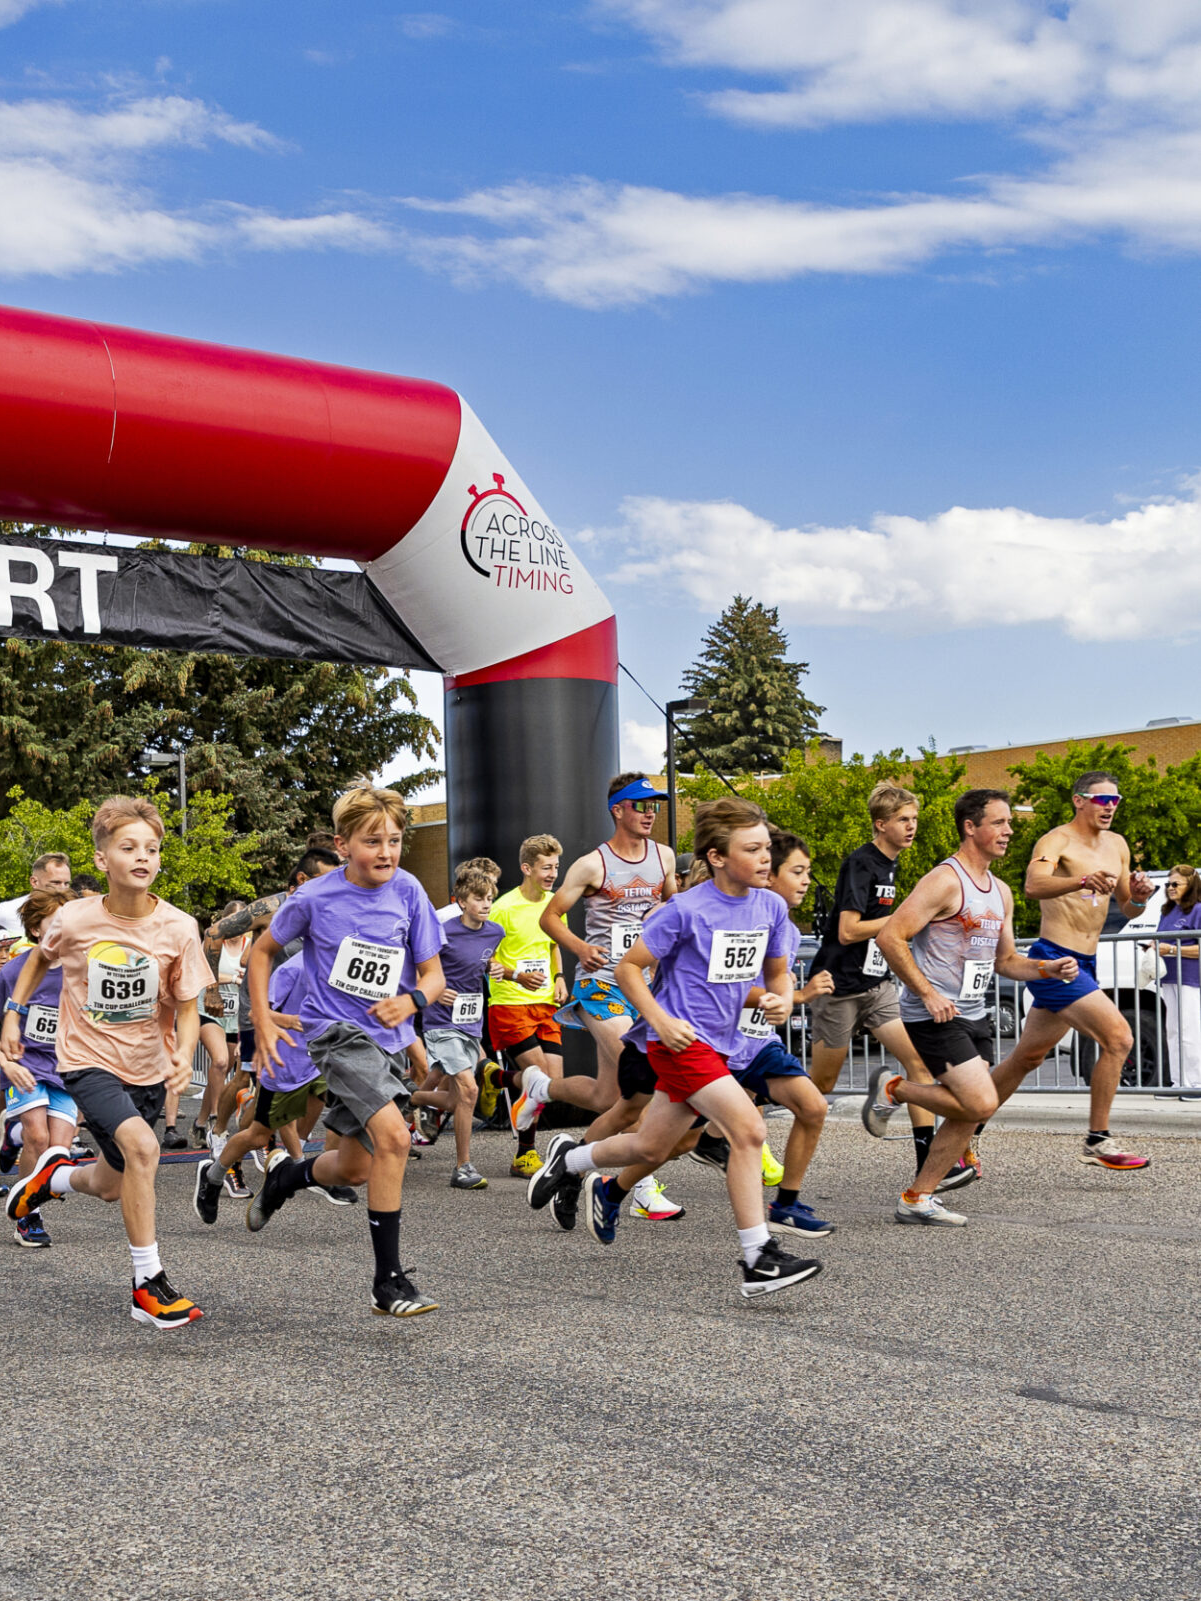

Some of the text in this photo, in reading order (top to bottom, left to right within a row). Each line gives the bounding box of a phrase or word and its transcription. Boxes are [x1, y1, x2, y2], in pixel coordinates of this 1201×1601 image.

[485, 512, 563, 548] ACROSS
[475, 536, 570, 570] THE LINE
[494, 564, 573, 594] TIMING
[623, 887, 653, 897] TETON
[98, 963, 124, 973] COMMUNITY
[724, 946, 757, 969] 552
[346, 957, 391, 986] 683
[101, 978, 145, 1000] 639
[335, 979, 391, 999] TIN CUP CHALLENGE
[94, 1001, 104, 1010] TIN
[119, 998, 152, 1010] CHALLENGE
[460, 1003, 477, 1016] 616
[36, 1017, 58, 1034] 65
